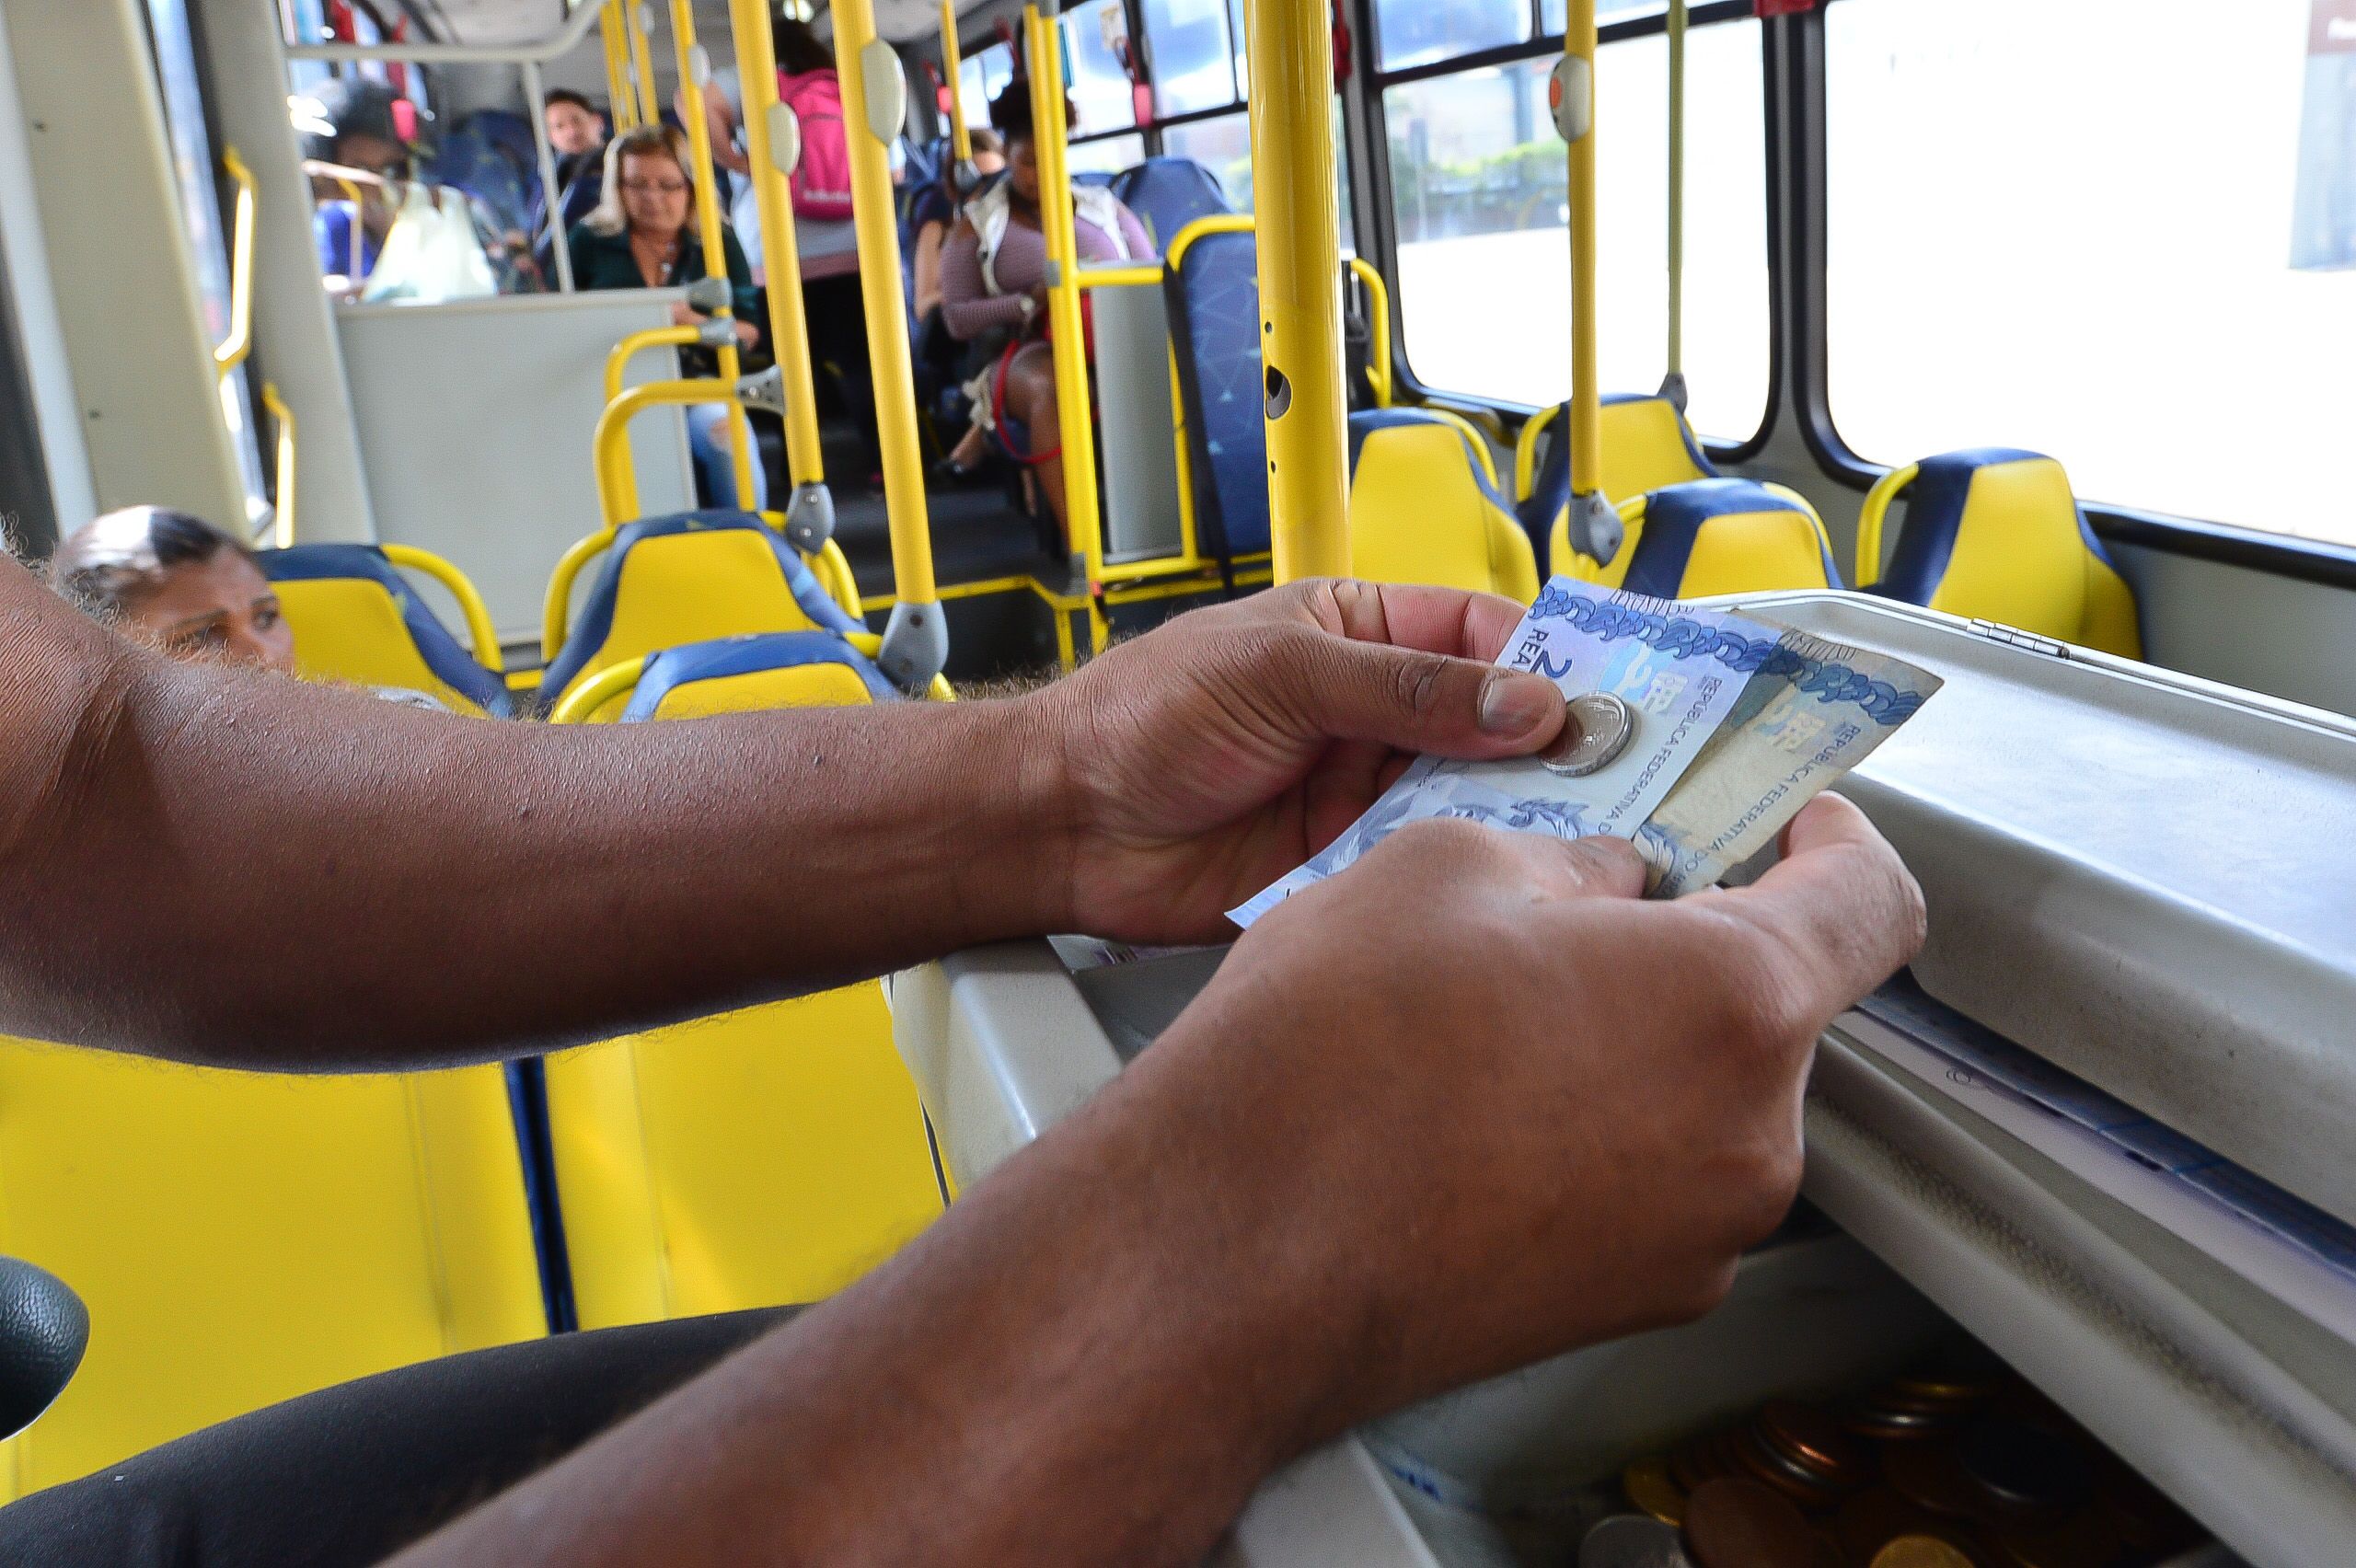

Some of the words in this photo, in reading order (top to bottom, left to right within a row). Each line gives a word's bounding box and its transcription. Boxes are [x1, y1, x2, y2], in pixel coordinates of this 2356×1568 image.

[1510, 628, 1550, 670] REA
[1529, 650, 1573, 679] 2
[1606, 746, 1672, 820] FEDERATIVA
[1711, 782, 1789, 852] FEDERATIVA
